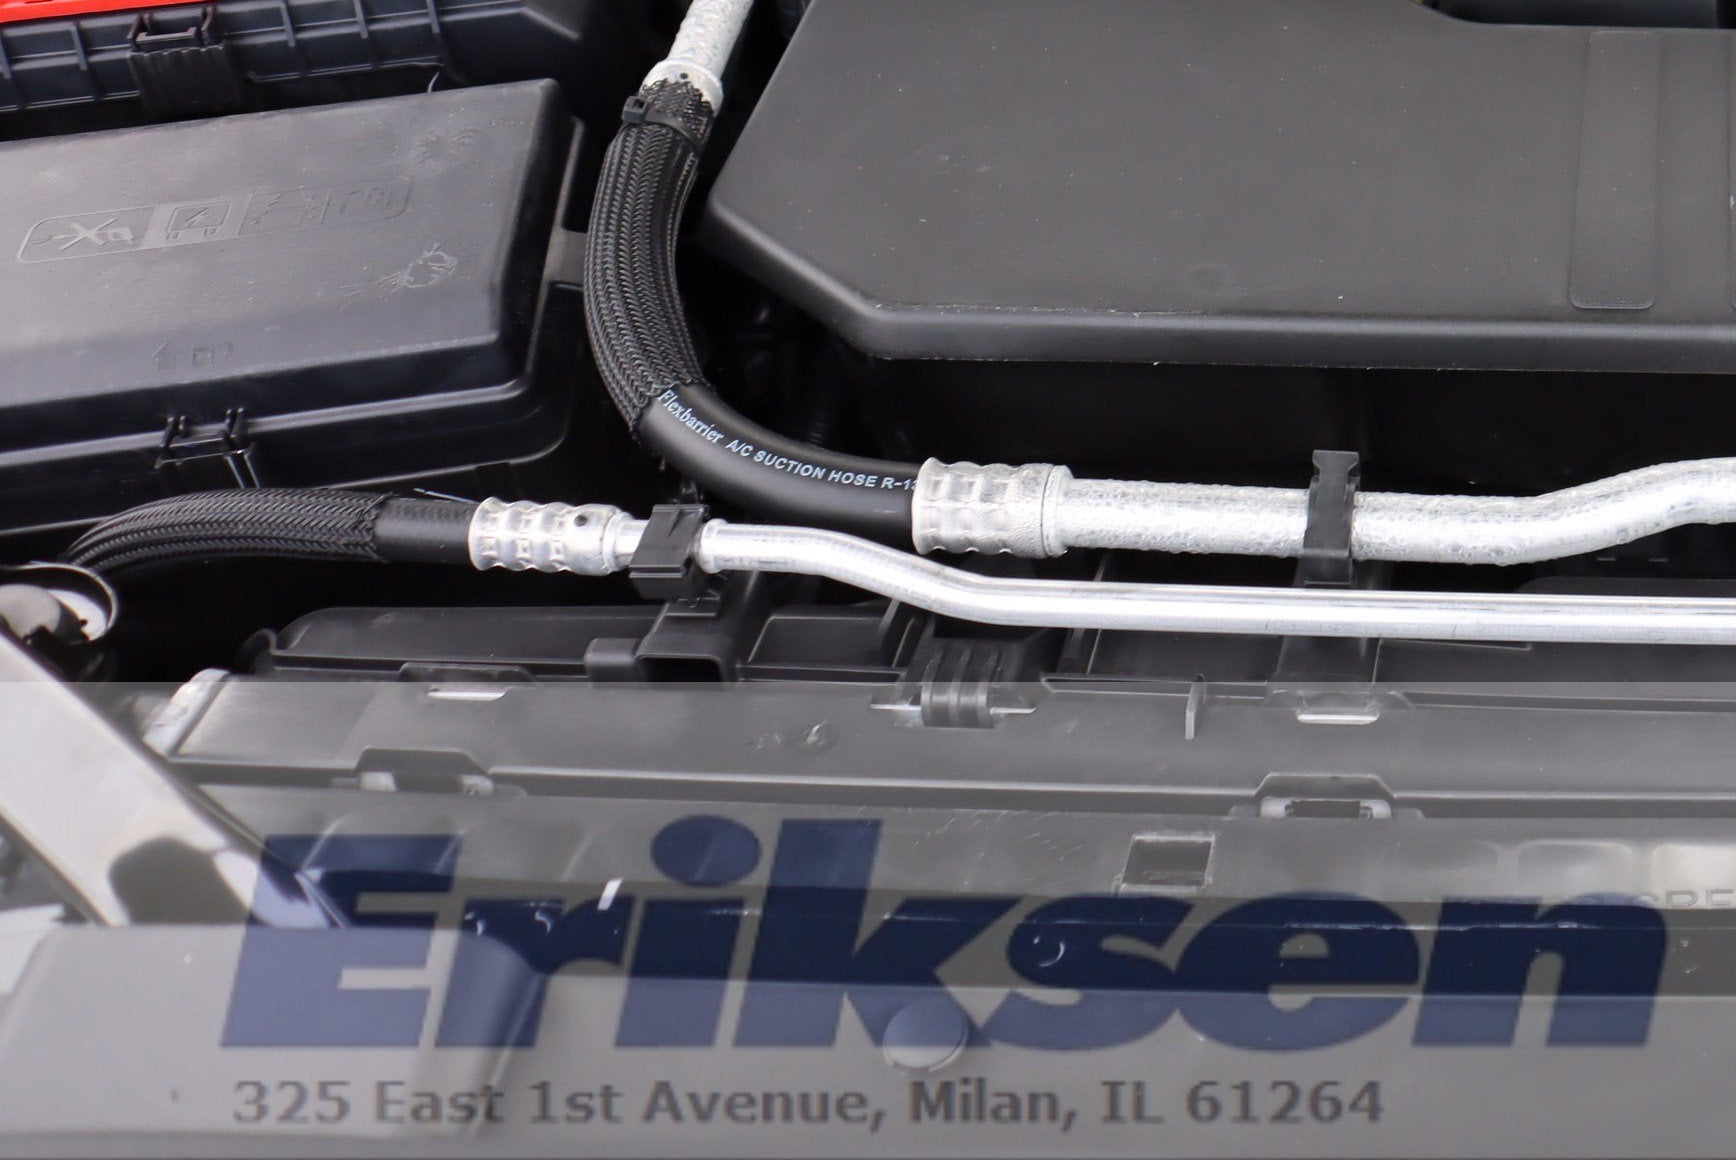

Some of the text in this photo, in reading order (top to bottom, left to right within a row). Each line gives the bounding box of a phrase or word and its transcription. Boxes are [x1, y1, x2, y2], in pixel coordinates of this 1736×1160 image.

[657, 388, 725, 444] Flexbarrier
[725, 438, 754, 458] A/C
[753, 449, 827, 481] SUCTION
[827, 468, 877, 489] HOSE
